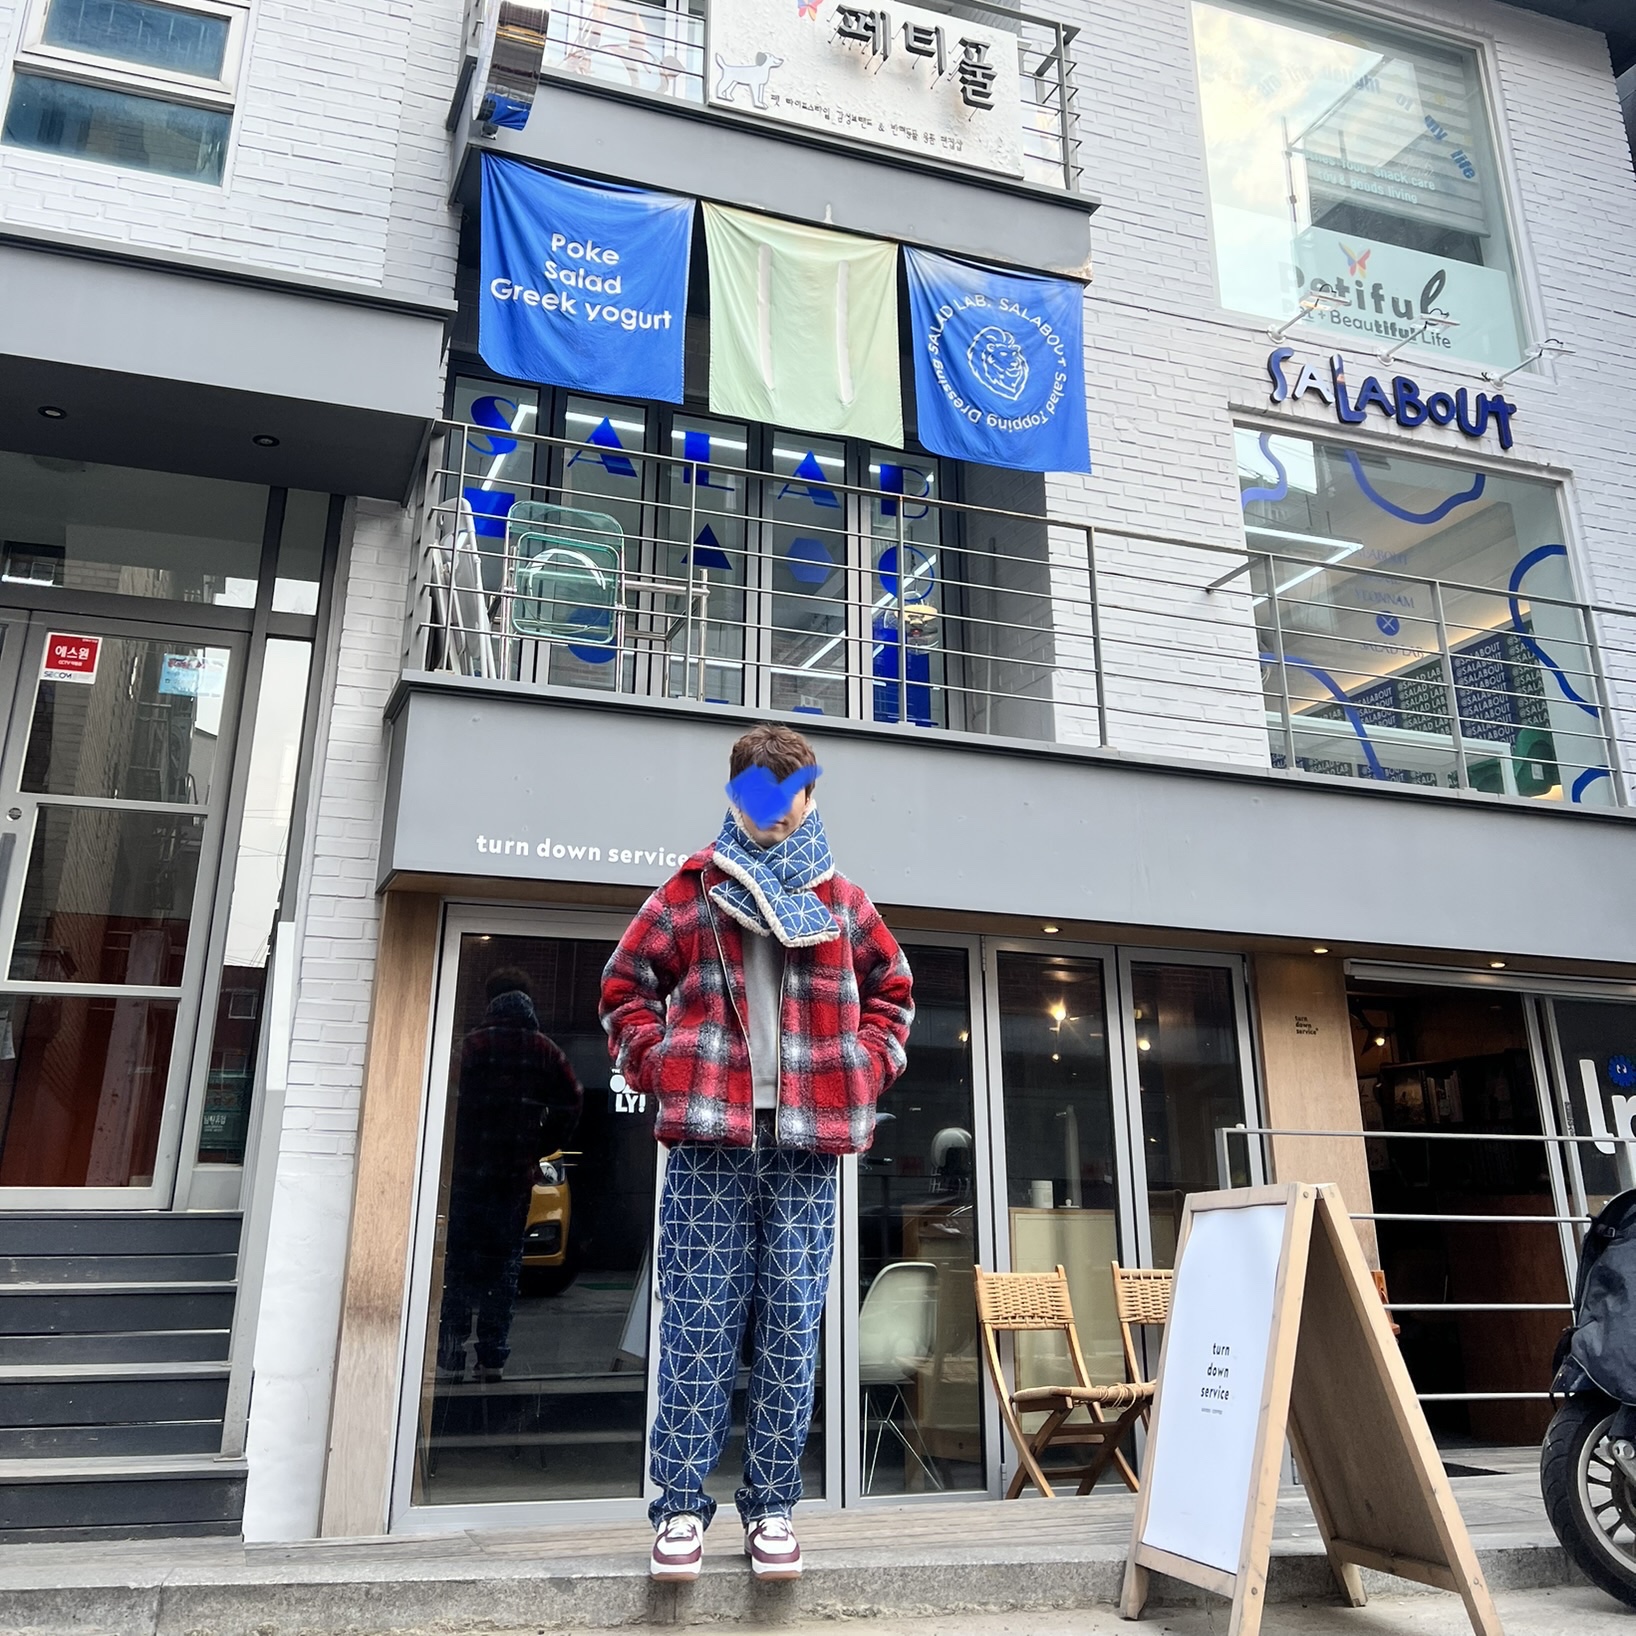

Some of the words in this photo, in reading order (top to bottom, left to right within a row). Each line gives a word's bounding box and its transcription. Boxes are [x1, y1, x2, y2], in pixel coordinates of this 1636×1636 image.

[836, 4, 998, 111] 페티풀
[878, 123, 885, 132] &
[1411, 177, 1436, 190] care
[551, 233, 620, 265] Poke
[490, 278, 577, 314] Greek
[585, 302, 672, 330] yogurt
[928, 305, 954, 355] SALAD
[1000, 298, 1067, 366] SALABOUT
[1422, 330, 1452, 349] Life
[933, 360, 982, 423] Dressing
[1046, 371, 1067, 414] Salad
[1267, 346, 1517, 450] SALABOUT
[987, 410, 1048, 432] Topping
[55, 645, 89, 660] 에스원
[44, 671, 72, 679] SECOM
[476, 835, 529, 856] turn
[536, 838, 601, 861] down
[608, 847, 689, 868] service
[615, 1093, 646, 1113] LY!
[1212, 1343, 1230, 1356] turn
[1207, 1362, 1229, 1378] down
[1201, 1385, 1230, 1400] service
